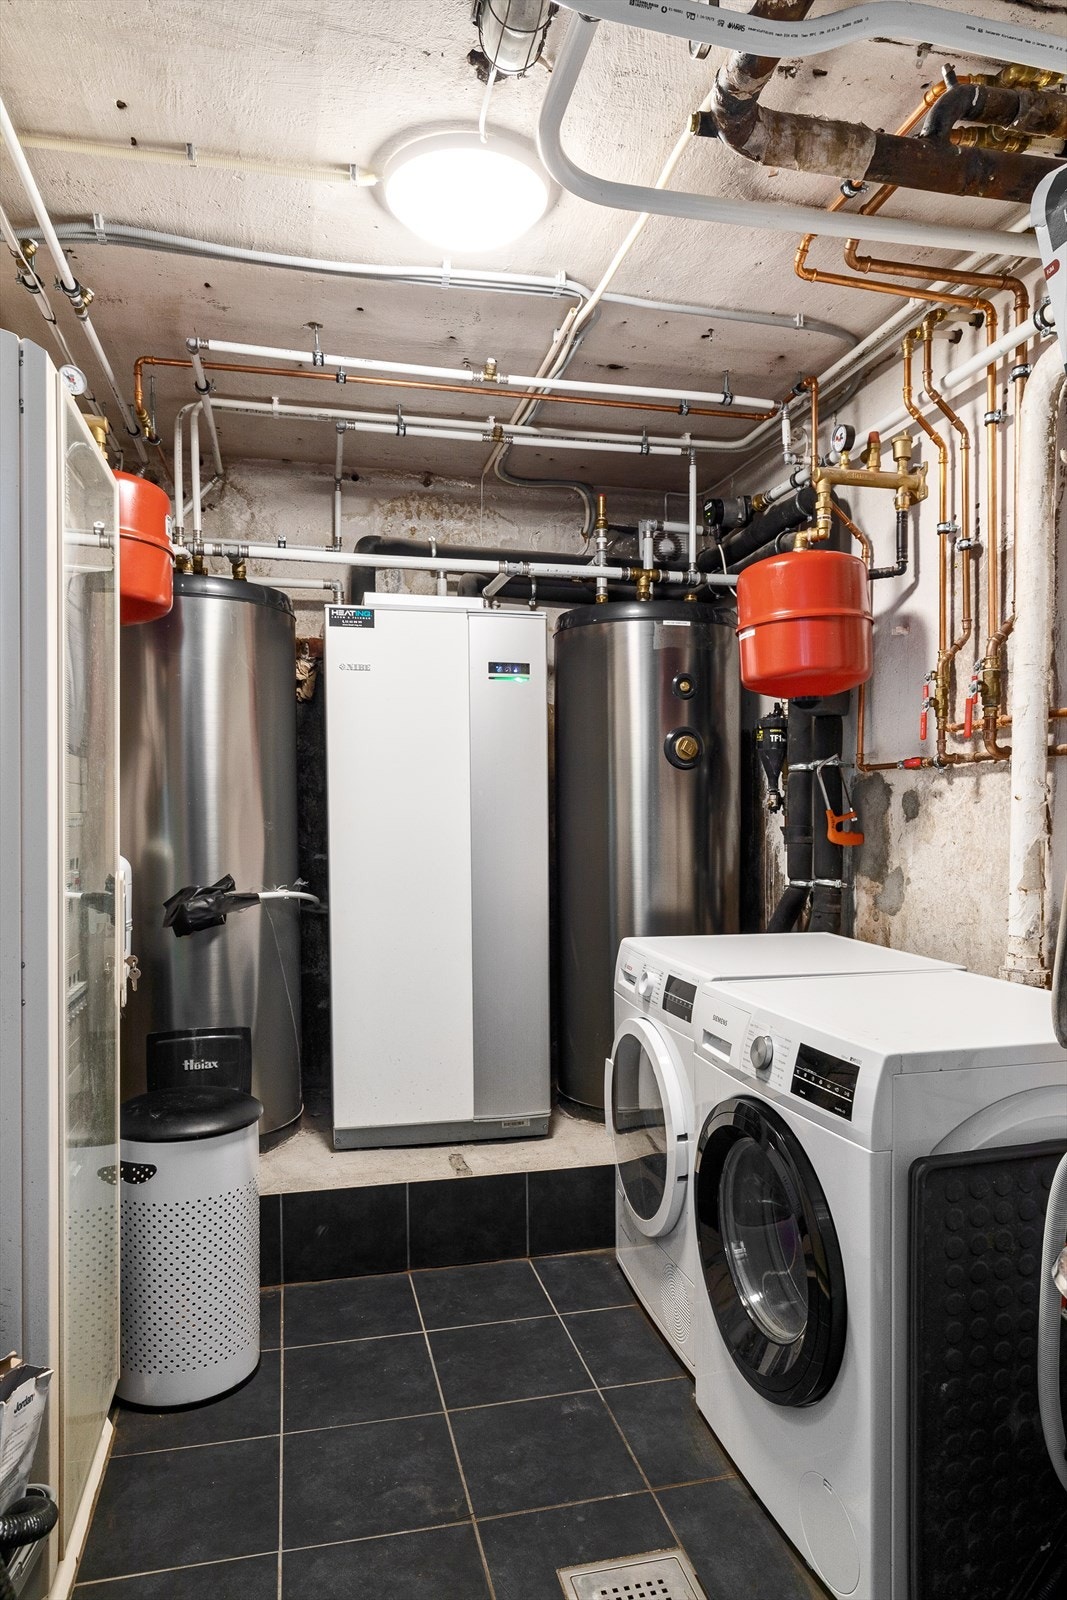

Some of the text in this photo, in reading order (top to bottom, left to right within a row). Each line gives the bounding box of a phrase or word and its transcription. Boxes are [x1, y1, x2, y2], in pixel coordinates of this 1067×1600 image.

[331, 609, 371, 617] HEATING
[346, 663, 371, 671] NIBE
[769, 734, 782, 742] TF1
[712, 1014, 728, 1026] SIEMENS
[14, 1394, 34, 1414] Jordan
